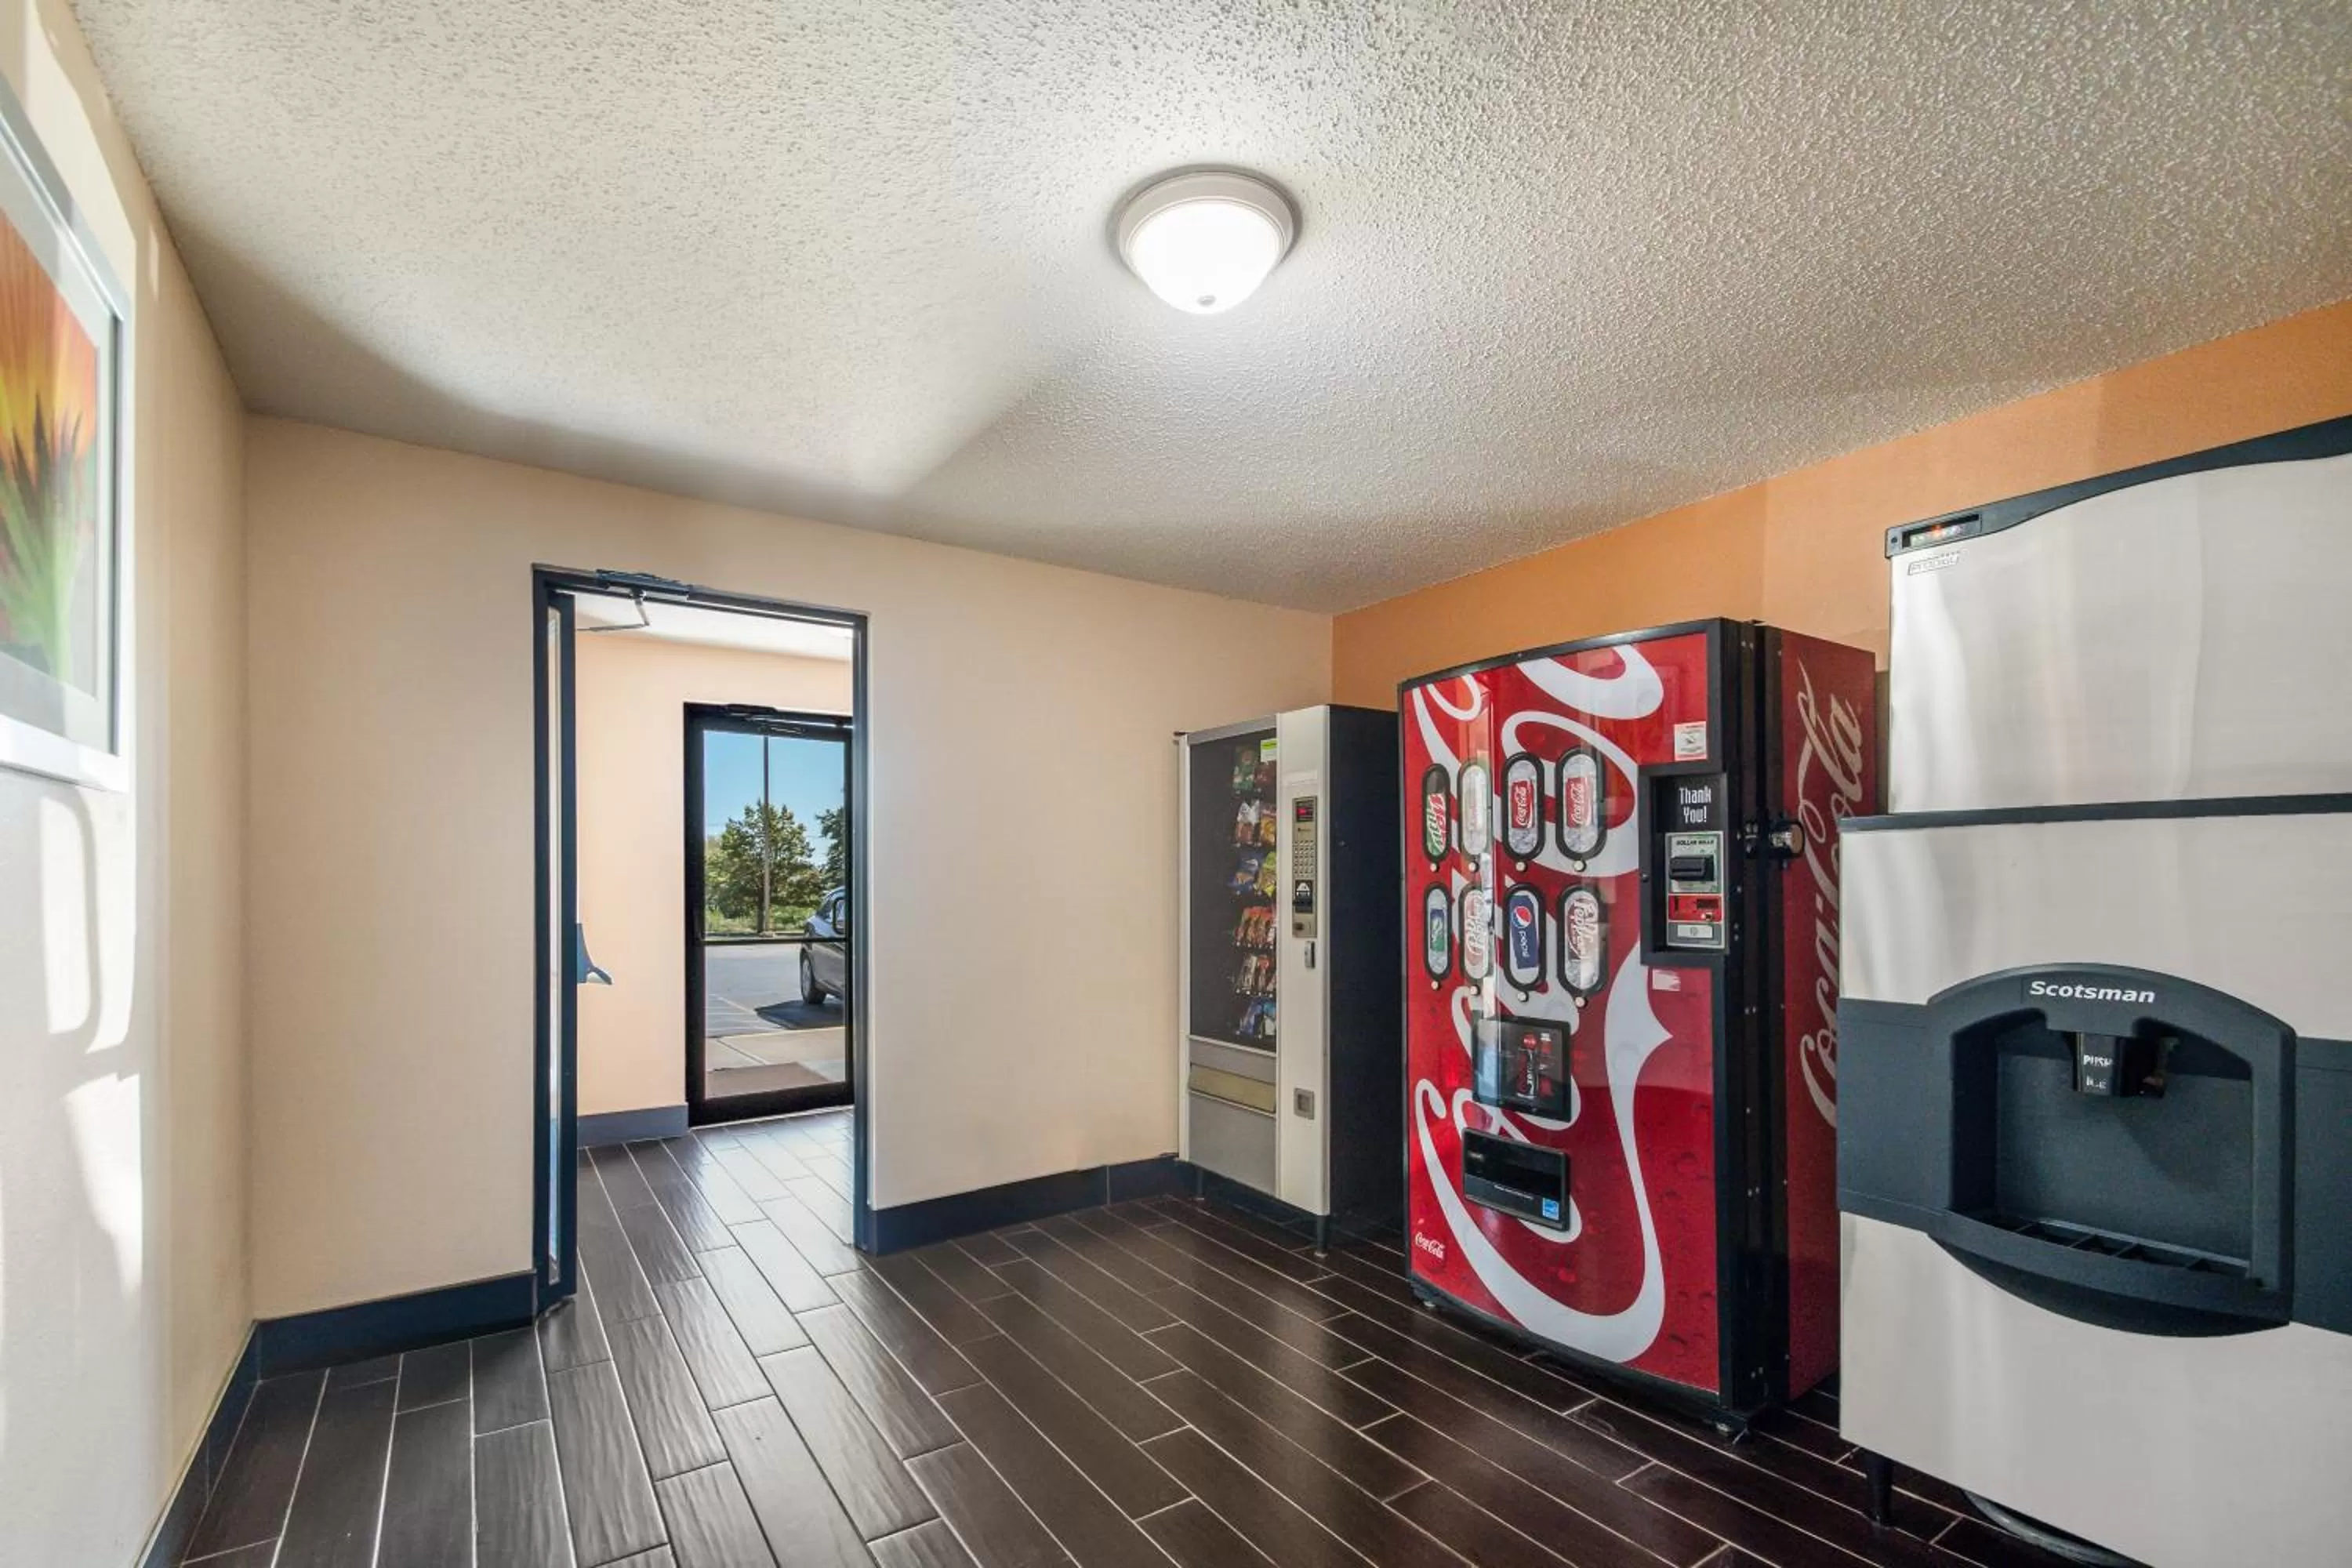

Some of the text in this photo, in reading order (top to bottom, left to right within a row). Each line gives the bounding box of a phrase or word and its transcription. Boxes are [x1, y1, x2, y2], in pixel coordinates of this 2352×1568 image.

[1679, 786, 1711, 805] Thank
[1683, 805, 1708, 824] You!
[2029, 980, 2155, 1004] Scotsman
